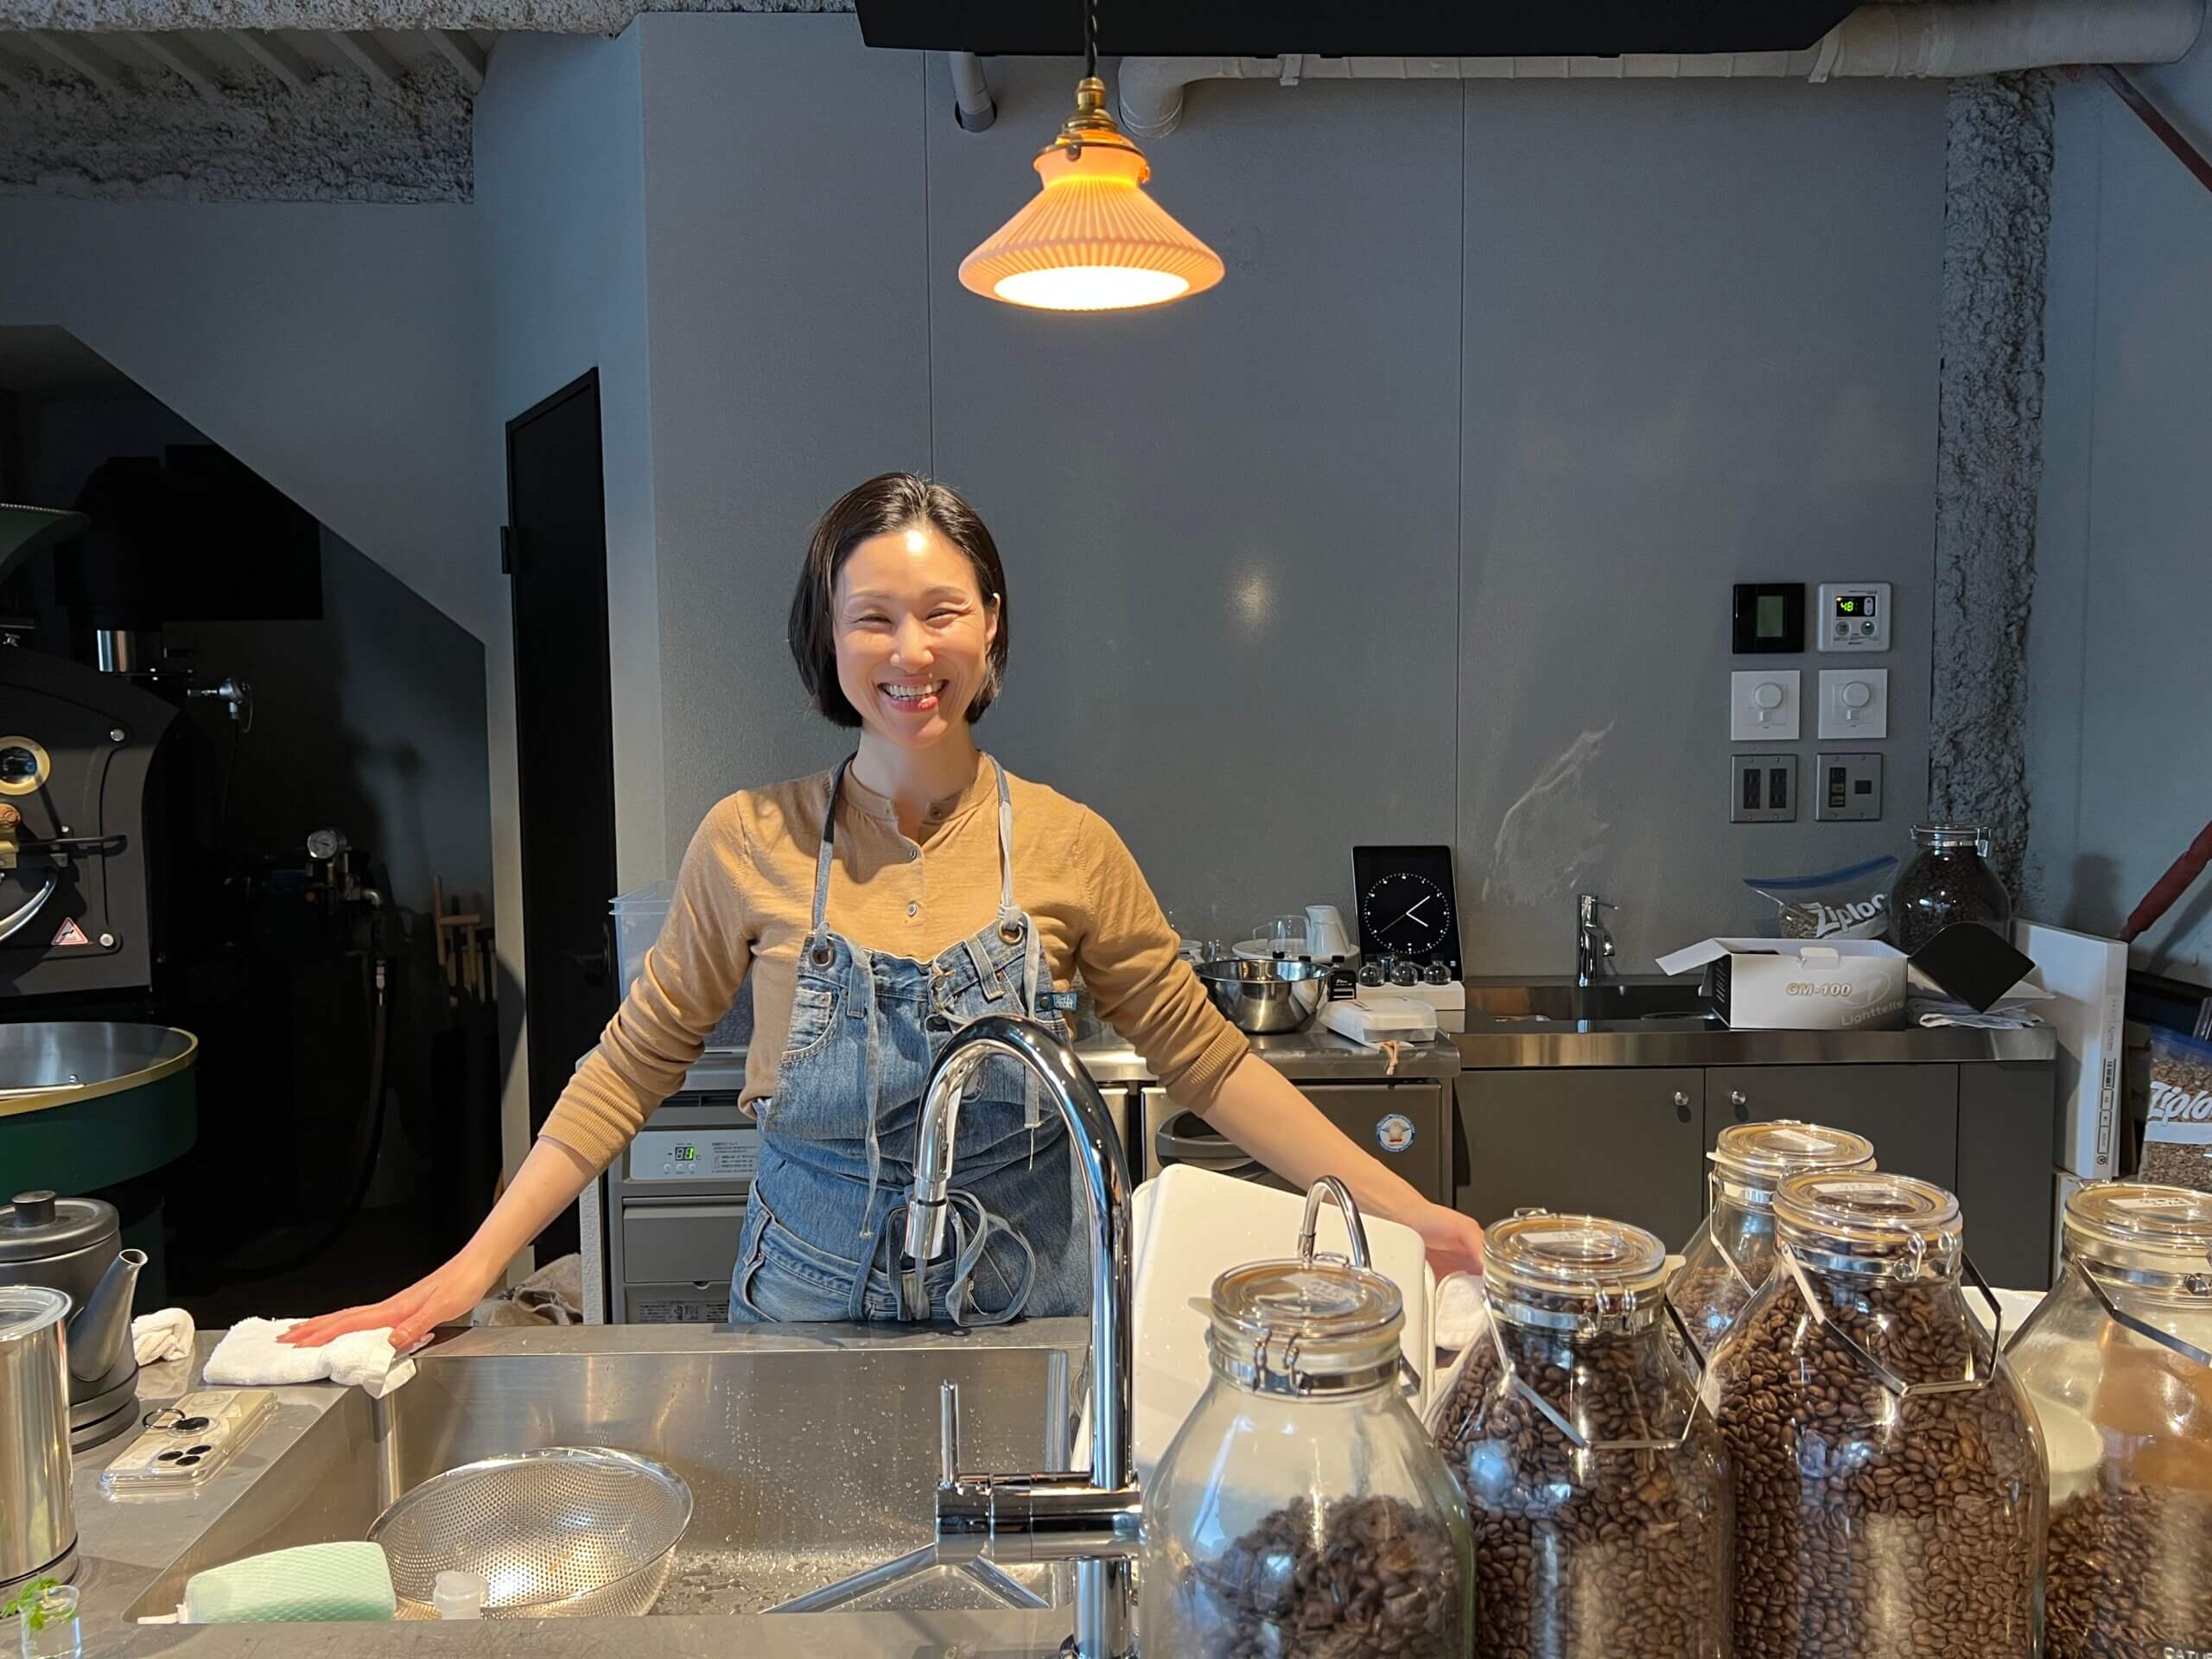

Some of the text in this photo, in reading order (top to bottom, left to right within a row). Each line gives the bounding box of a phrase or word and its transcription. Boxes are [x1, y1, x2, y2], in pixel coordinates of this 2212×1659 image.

[1840, 601, 1854, 613] 48
[1786, 982, 1853, 996] GM-100
[2146, 1081, 2212, 1128] Ziplo
